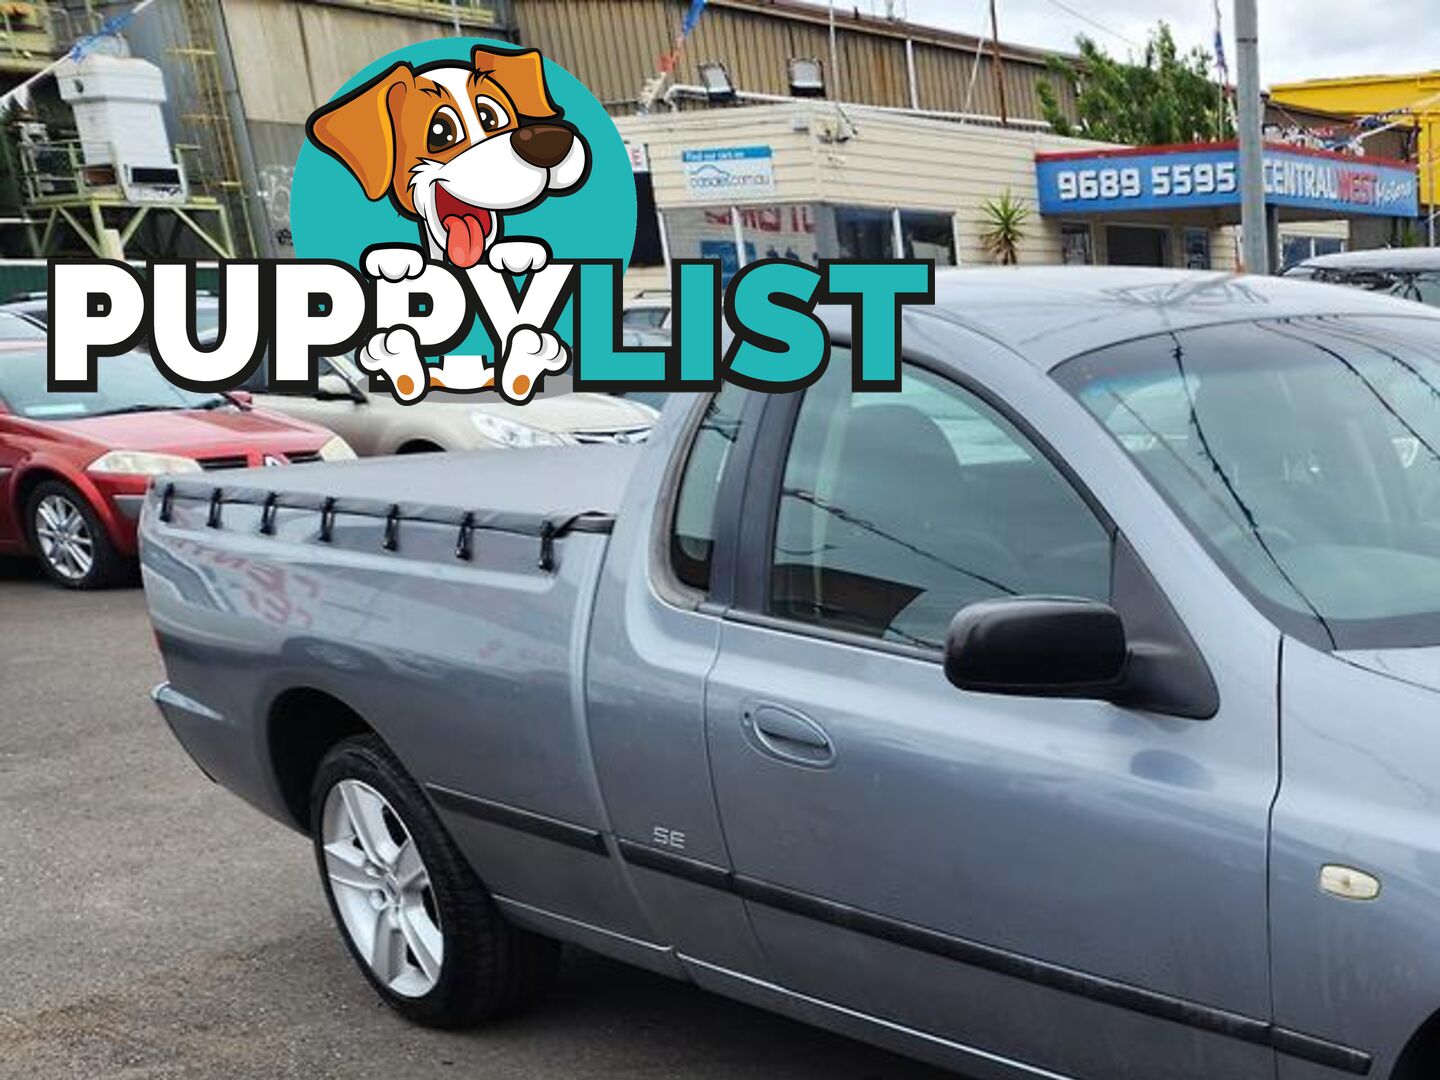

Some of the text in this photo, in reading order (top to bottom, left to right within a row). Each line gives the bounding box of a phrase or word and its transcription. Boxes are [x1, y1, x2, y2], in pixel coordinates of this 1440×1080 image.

[1057, 161, 1237, 201] 9689 5595
[653, 826, 685, 849] SE
